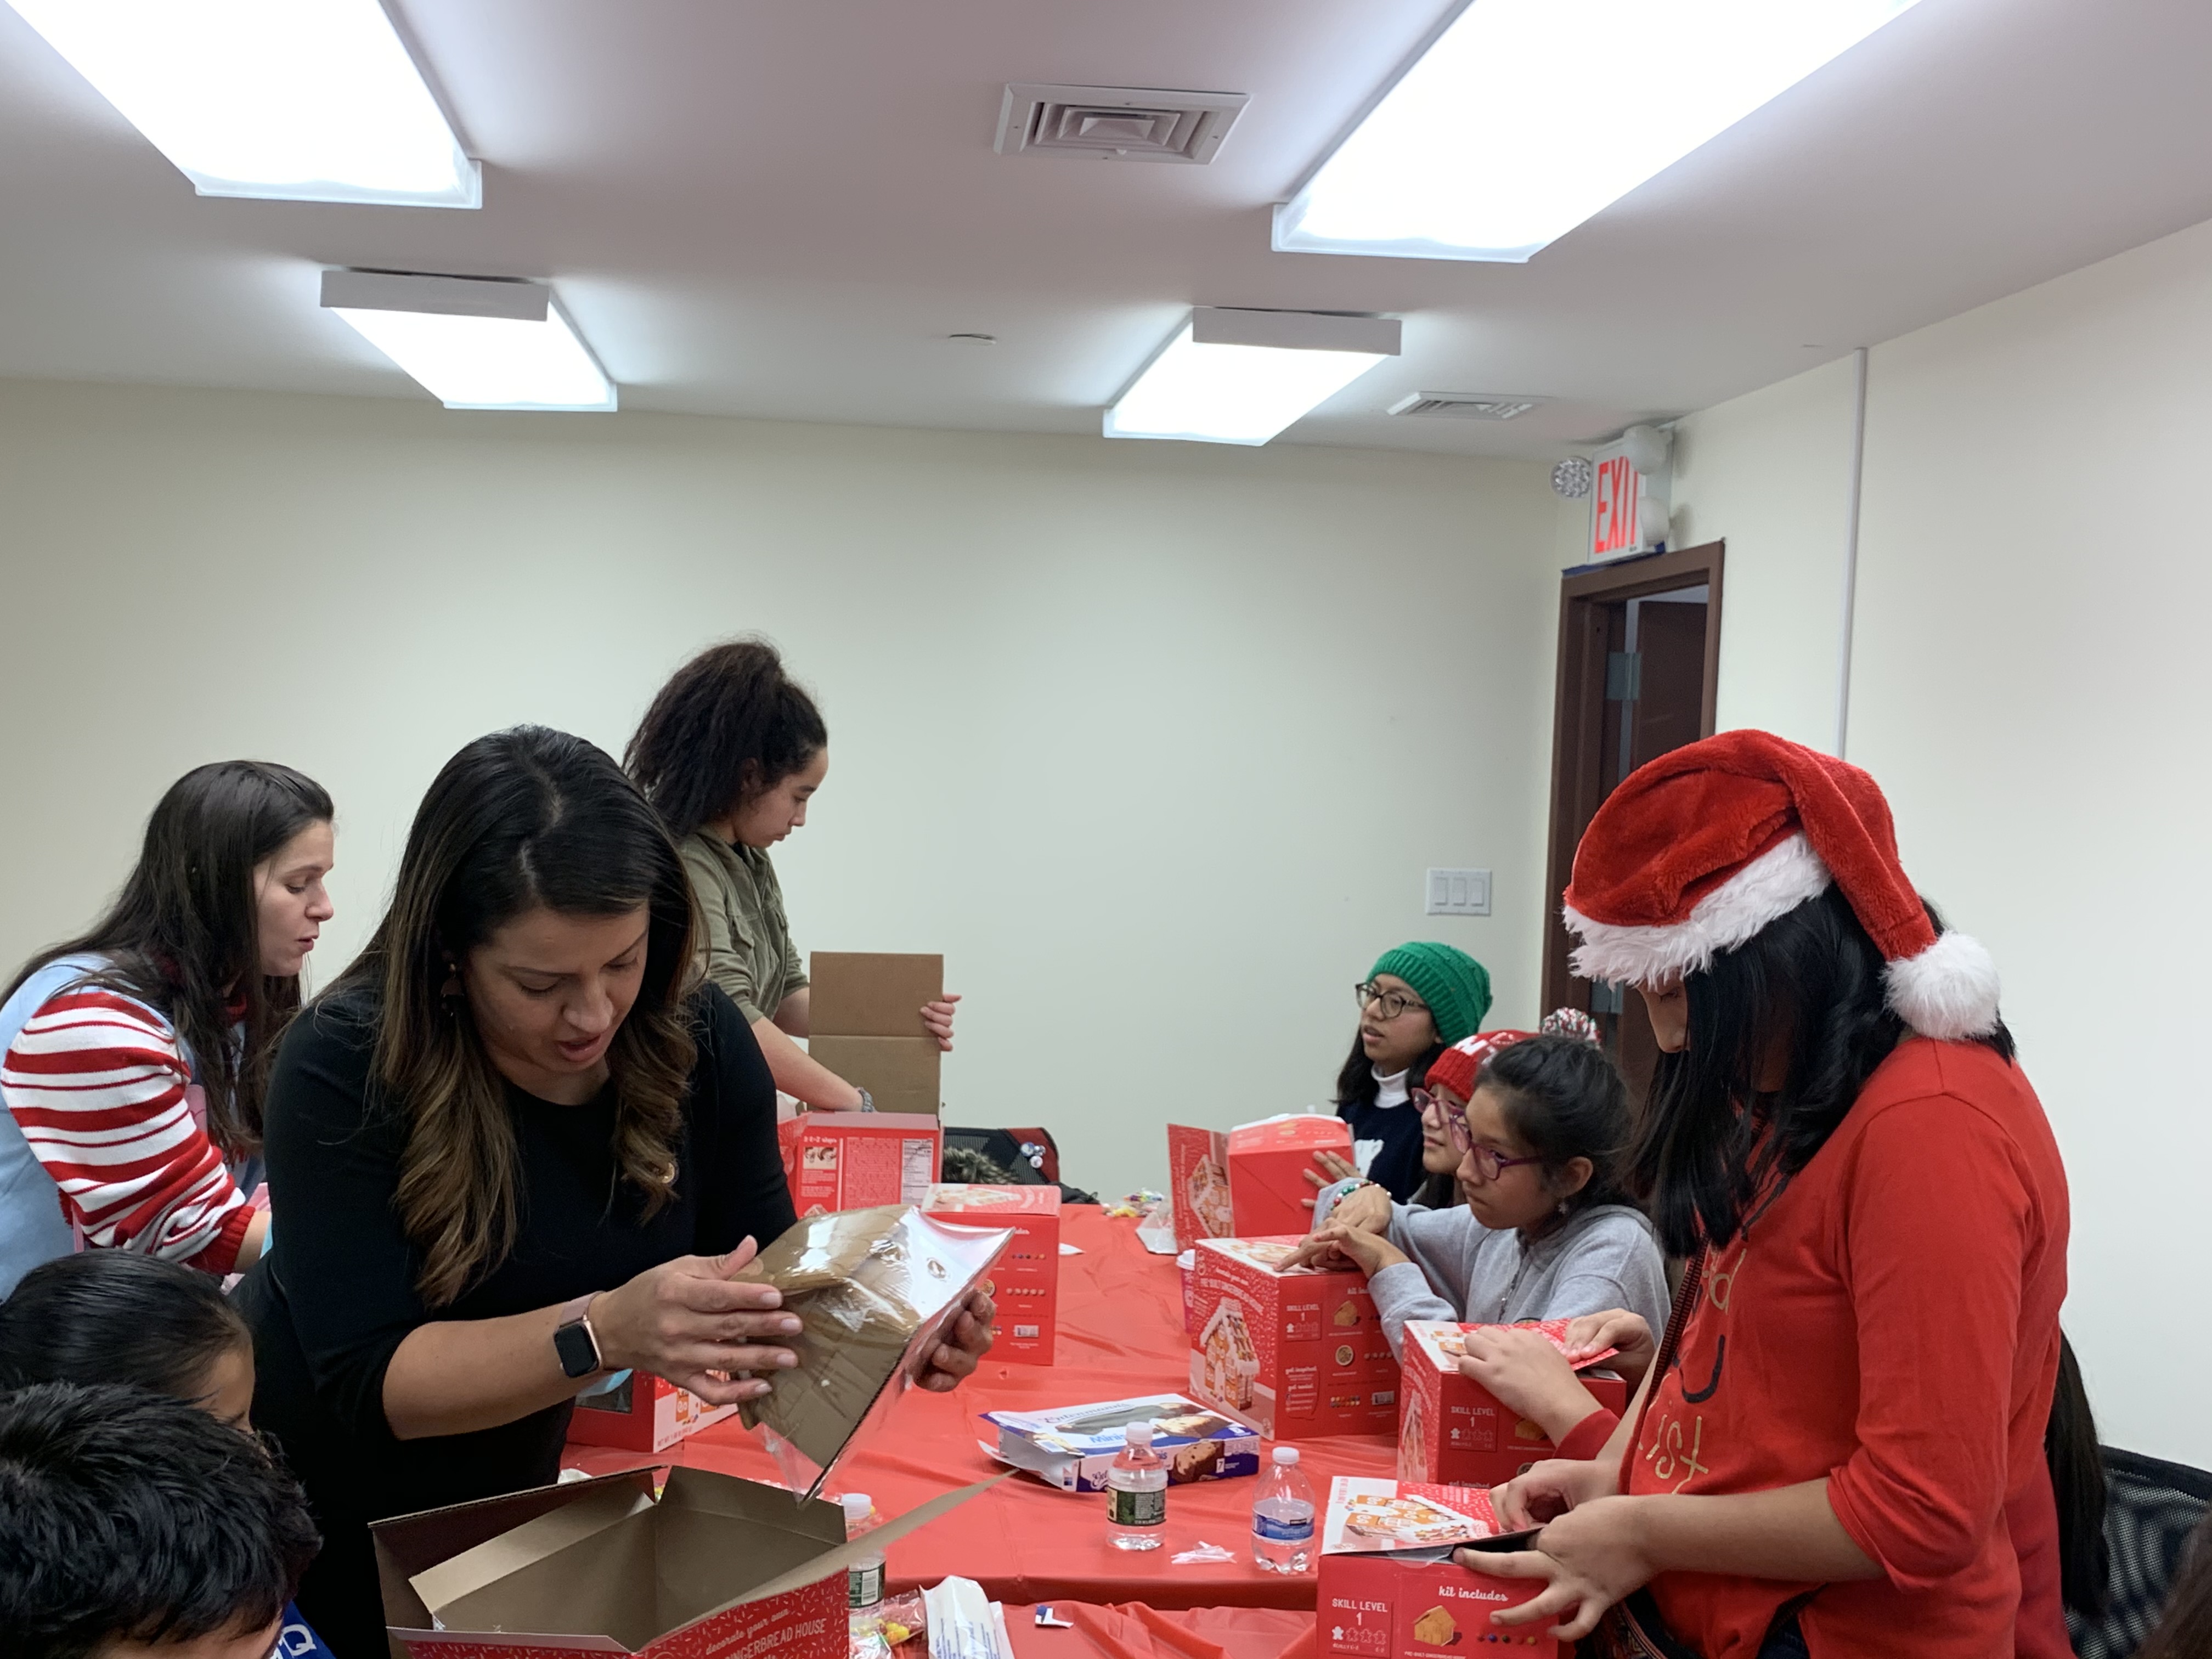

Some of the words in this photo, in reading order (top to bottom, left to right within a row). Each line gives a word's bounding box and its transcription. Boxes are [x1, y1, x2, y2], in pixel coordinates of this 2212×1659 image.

[1594, 456, 1639, 554] EXIT
[1301, 1312, 1305, 1321] 1
[1451, 1406, 1470, 1415] SKILL
[1472, 1408, 1495, 1417] LEVEL
[1470, 1417, 1475, 1427] 1
[1217, 1461, 1223, 1470] 7
[1438, 1585, 1455, 1597] kit
[1458, 1588, 1509, 1601] includes
[1332, 1598, 1357, 1609] SKILL
[1359, 1601, 1388, 1612] LEVEL
[1356, 1612, 1362, 1626] 1
[795, 1618, 827, 1639] HOUSE
[706, 1629, 744, 1655] decorate
[747, 1618, 768, 1639] your
